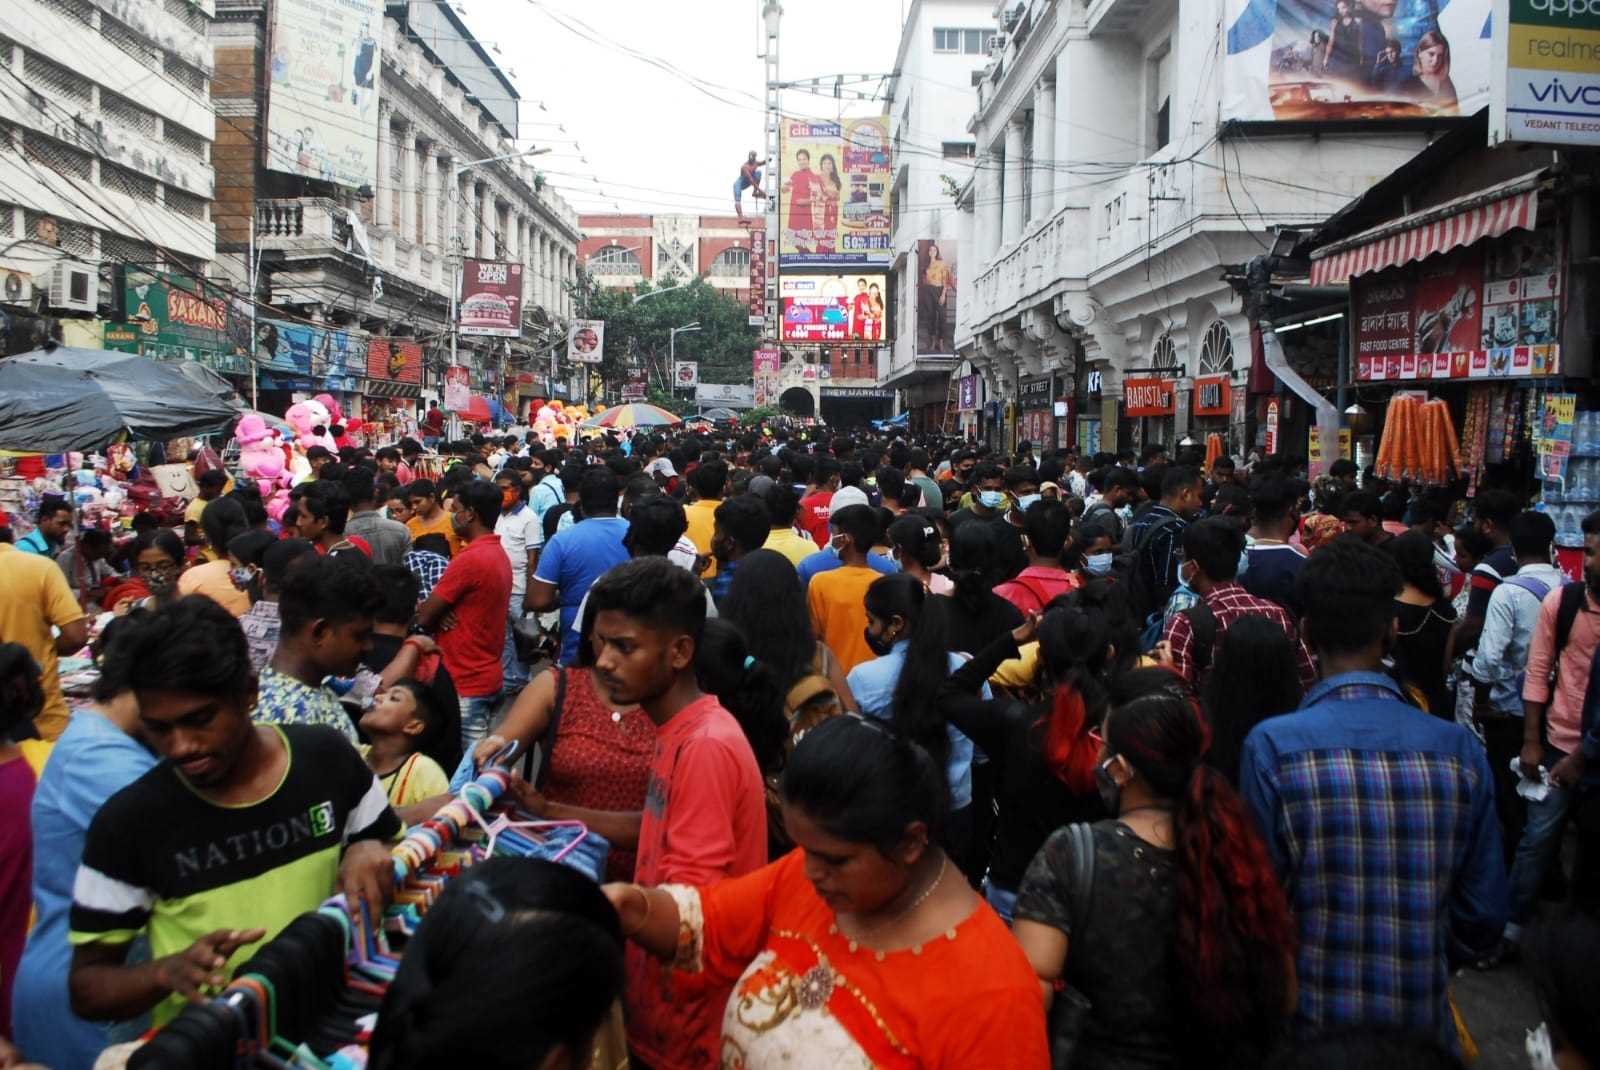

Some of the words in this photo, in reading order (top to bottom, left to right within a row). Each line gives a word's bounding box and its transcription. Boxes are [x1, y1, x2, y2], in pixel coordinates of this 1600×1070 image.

[1528, 37, 1600, 60] realme
[1528, 78, 1600, 106] vivo
[792, 123, 809, 136] citi
[1525, 119, 1562, 130] VEDANT
[478, 271, 507, 281] OPEN
[826, 389, 847, 397] NEW
[848, 389, 887, 397] MARKET
[1126, 385, 1162, 409] BARISTA
[174, 815, 311, 878] NATION
